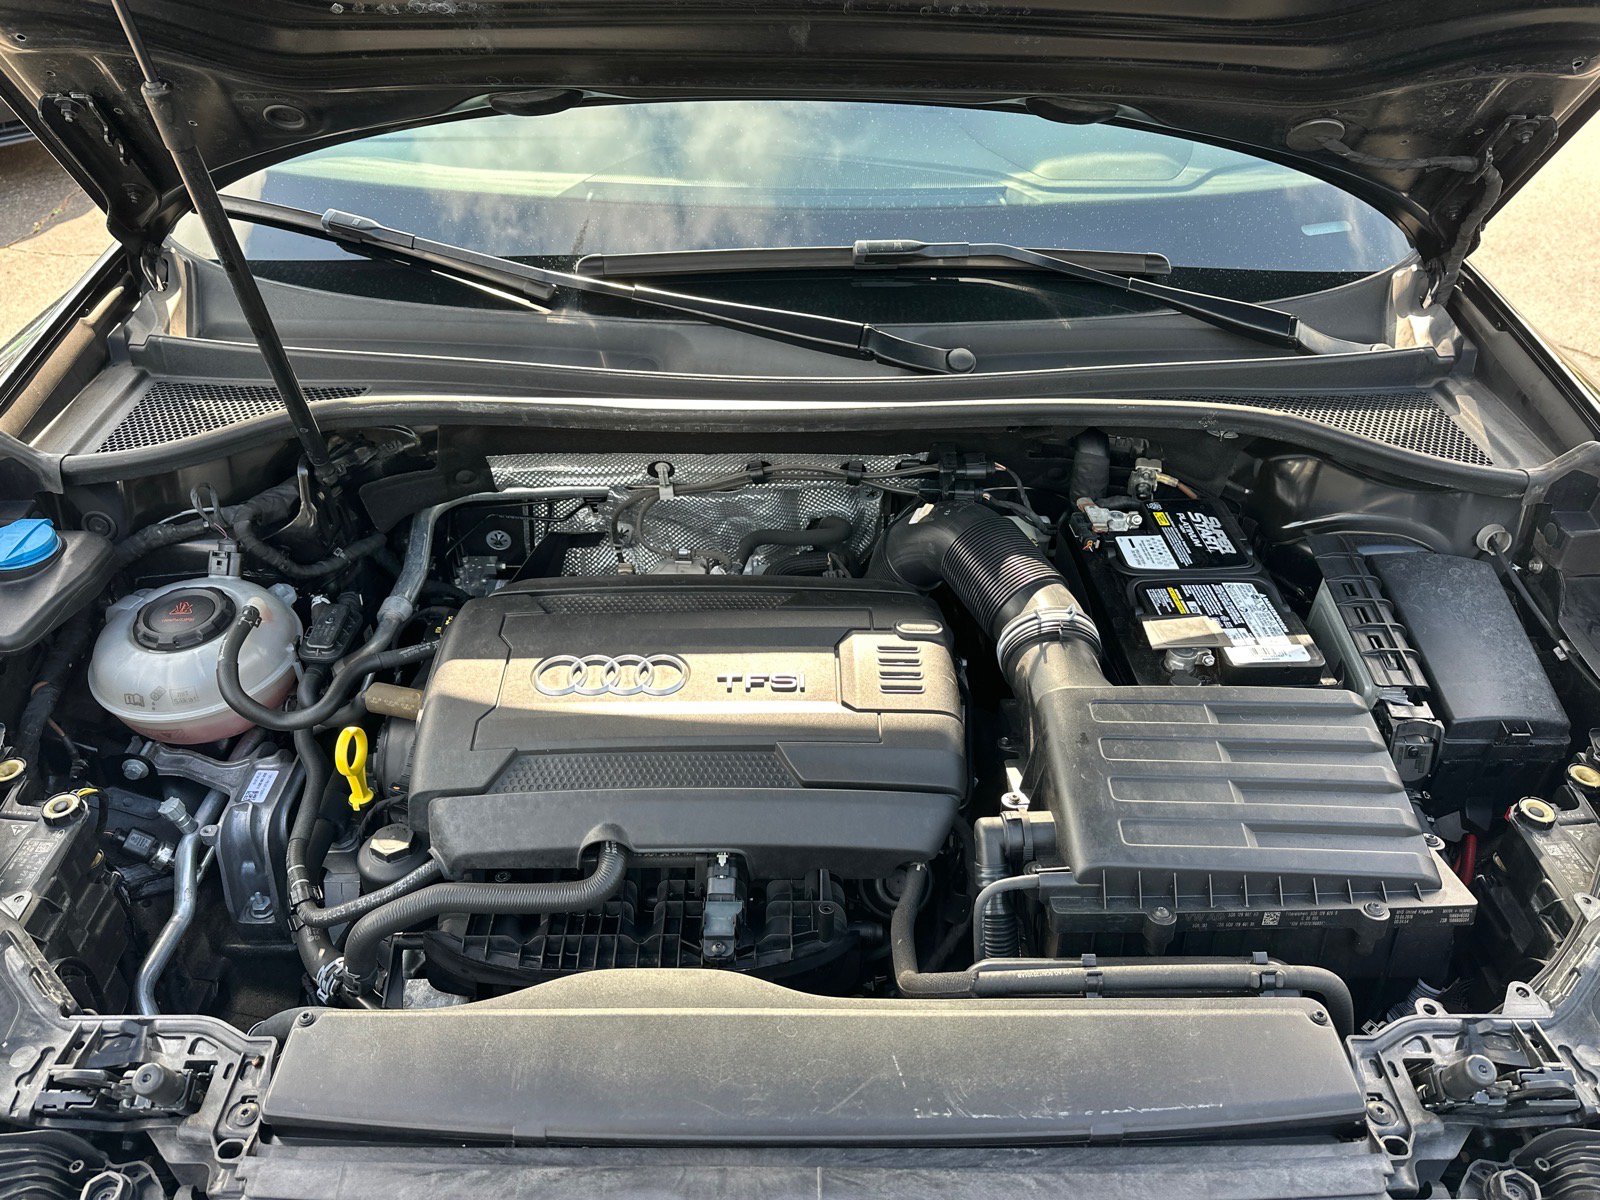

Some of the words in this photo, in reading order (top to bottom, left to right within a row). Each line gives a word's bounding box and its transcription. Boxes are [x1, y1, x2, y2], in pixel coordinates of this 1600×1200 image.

[1176, 513, 1203, 547] PLATINUM
[1187, 511, 1220, 553] START
[1205, 516, 1238, 555] SUPER
[716, 673, 806, 694] TFSI
